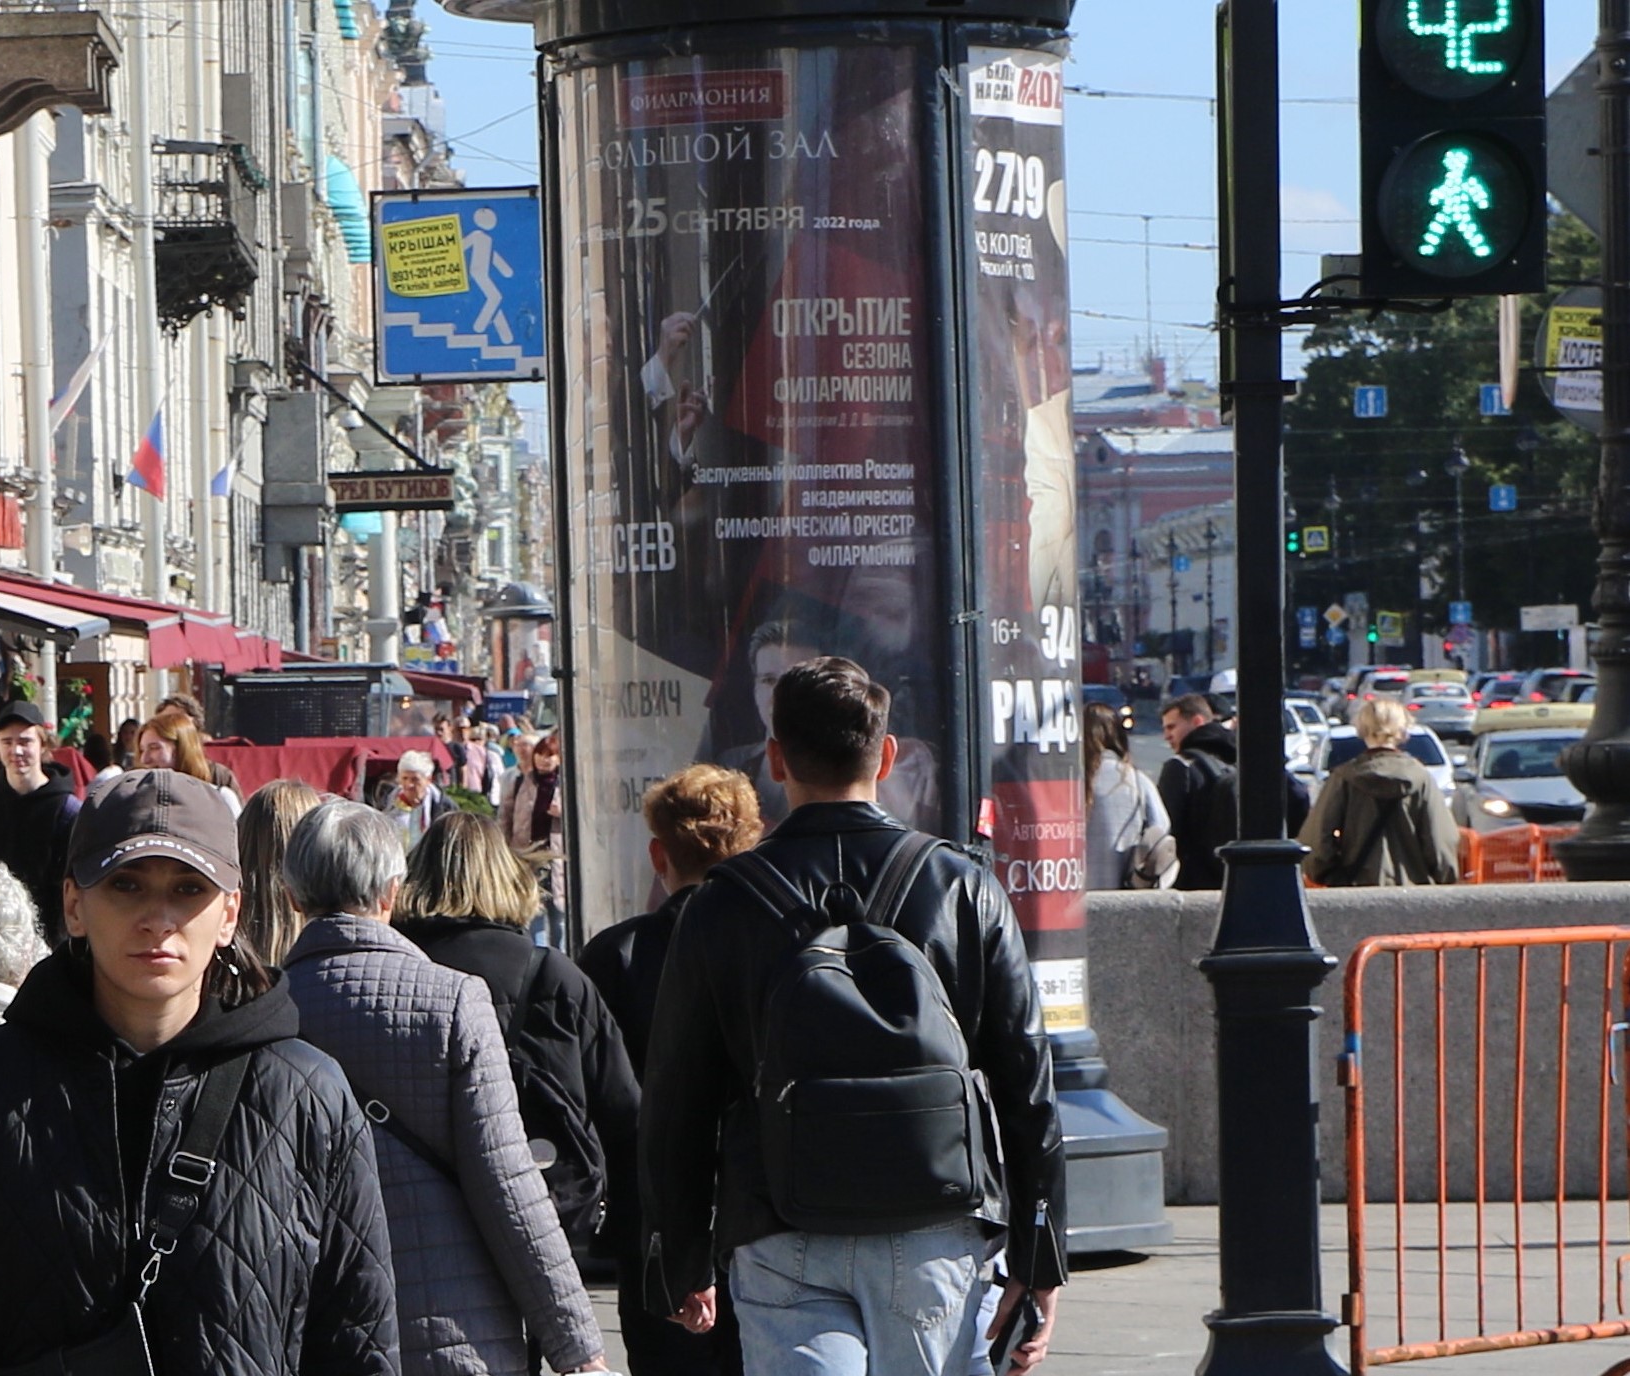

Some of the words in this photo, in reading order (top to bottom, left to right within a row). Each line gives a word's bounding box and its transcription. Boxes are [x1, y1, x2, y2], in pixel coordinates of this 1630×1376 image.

[630, 86, 771, 112] ФИЛАРМОНИЯ
[587, 126, 752, 172] БОЛЬШОЙ
[769, 130, 838, 160] ЗАЛ
[626, 197, 668, 238] 25
[672, 206, 805, 234] СЕНТЯБРЯ
[813, 216, 846, 229] 2022
[848, 216, 881, 230] года
[389, 235, 456, 254] КРЫШАМ
[772, 297, 912, 337] ОТКРЫТИЕ
[842, 343, 913, 369] СЕЗОНА
[774, 376, 913, 403] ФИЛАРМОНИИ
[691, 463, 785, 487] Заслуженный
[789, 463, 862, 482] коллектив
[865, 459, 915, 480] России
[374, 479, 449, 499] БУТИКОВ
[801, 488, 915, 508] академический
[715, 512, 851, 539] СИМФОНИЧЕСКИЙ
[853, 514, 915, 537] ОРКЕСТР
[808, 546, 915, 566] ФИЛАРМОНИИ
[990, 618, 1022, 644] 16+
